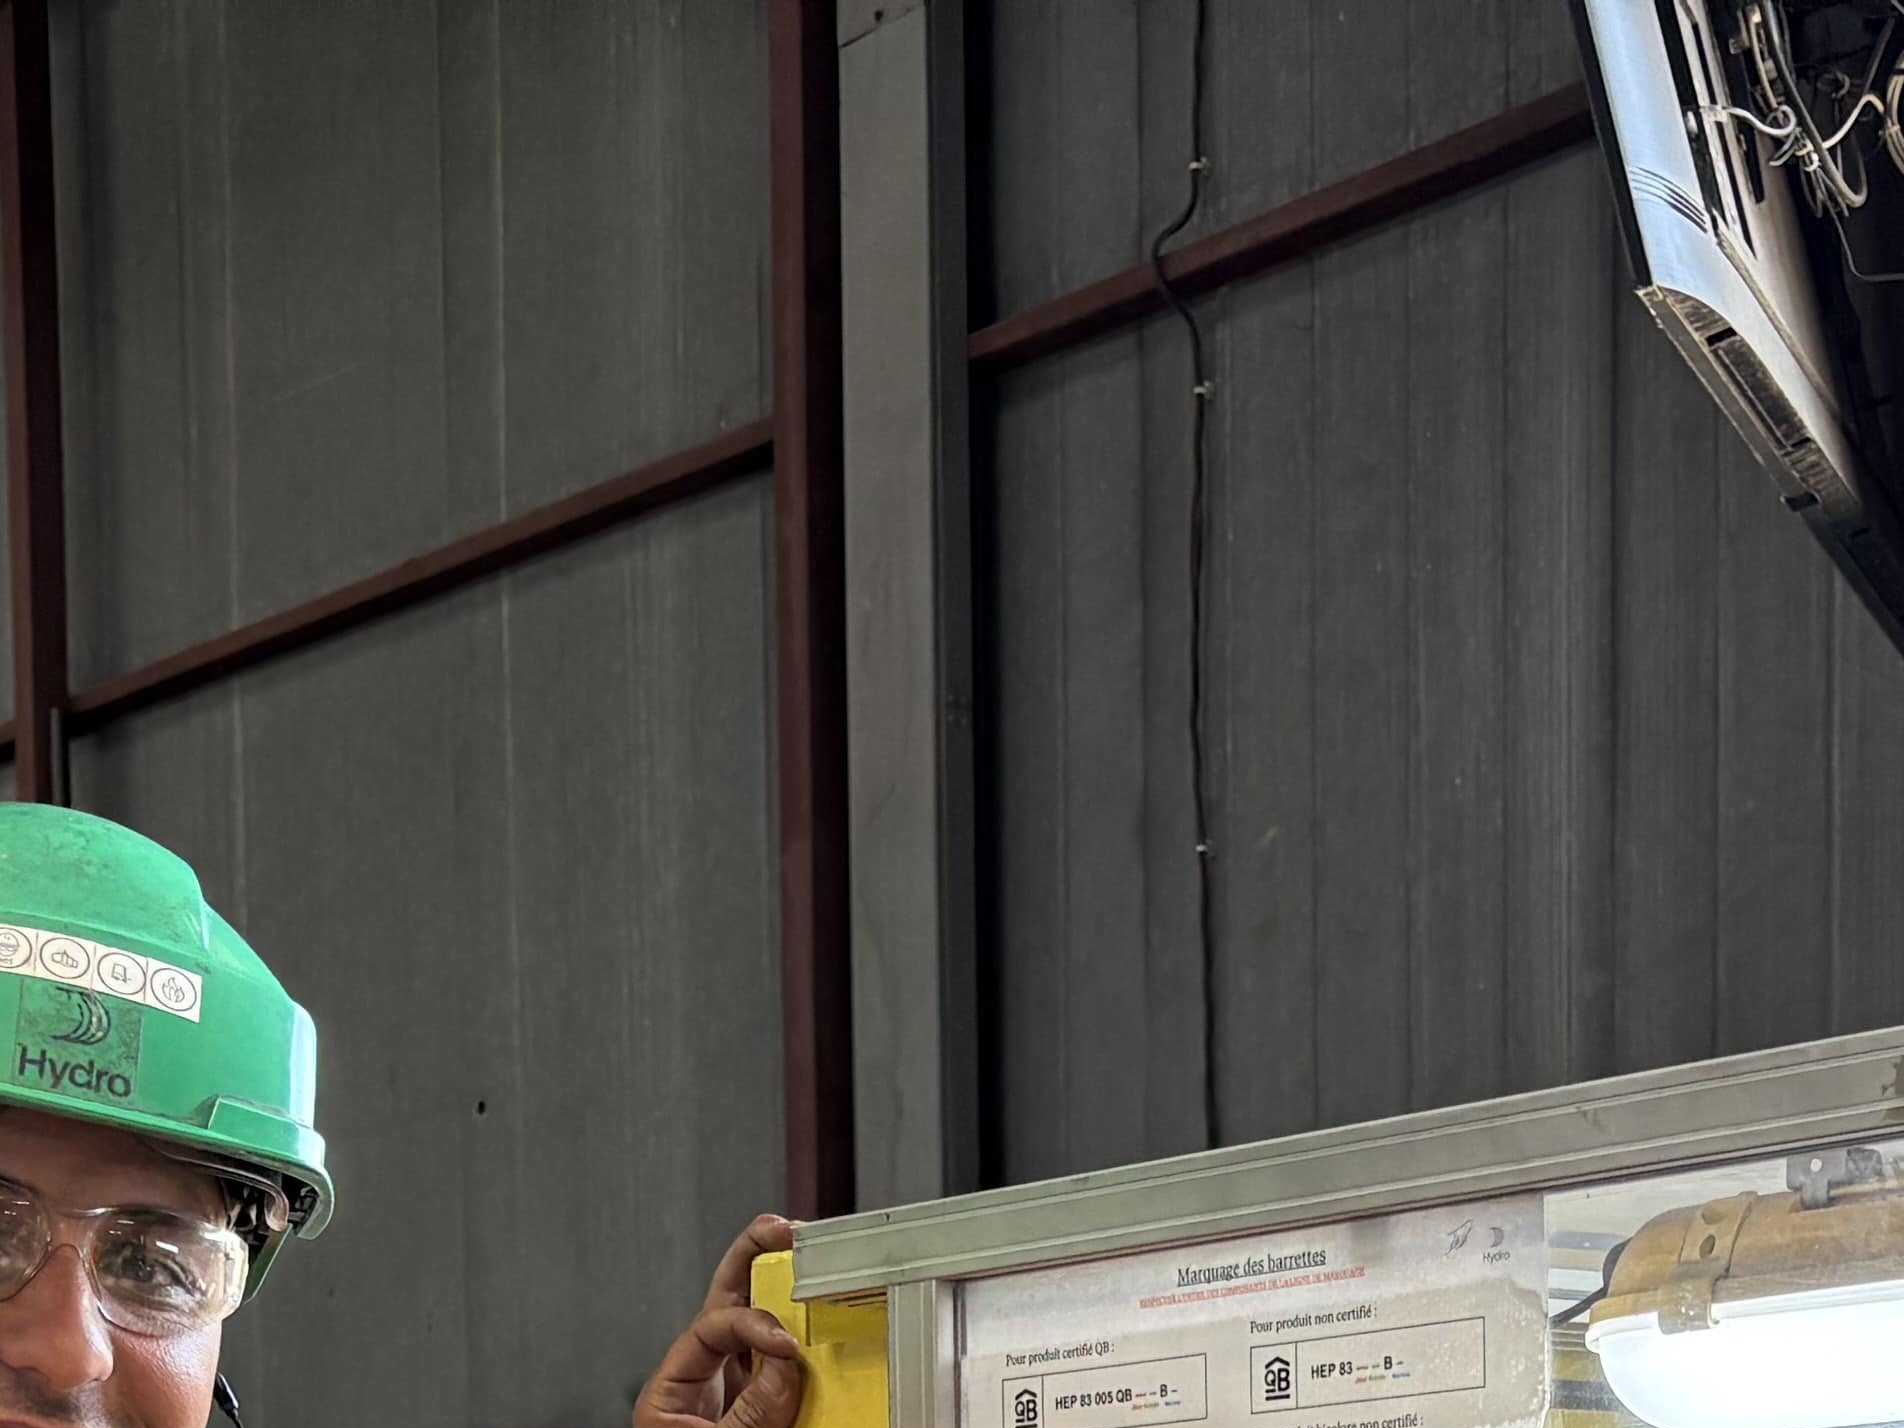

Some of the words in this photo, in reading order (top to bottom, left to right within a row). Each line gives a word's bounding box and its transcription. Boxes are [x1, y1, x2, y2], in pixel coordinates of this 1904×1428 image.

[18, 1045, 132, 1097] Hydro
[1177, 1262, 1240, 1287] Marquage
[1244, 1256, 1265, 1276] des
[1267, 1250, 1327, 1271] barrettes
[1482, 1251, 1511, 1264] Hydro
[1250, 1320, 1272, 1334] Pour
[1276, 1312, 1312, 1333] produit
[1315, 1314, 1334, 1325] non
[1336, 1304, 1371, 1322] certifié
[1006, 1354, 1026, 1367] Pour
[1028, 1348, 1060, 1366] produit
[1062, 1344, 1093, 1359] certifié
[1095, 1341, 1109, 1356] QB
[1311, 1363, 1336, 1380] HEP
[1339, 1361, 1353, 1376] 83
[1384, 1356, 1393, 1369] B
[1055, 1394, 1076, 1410] HEP
[1080, 1393, 1092, 1407] 83
[1095, 1391, 1114, 1406] 005
[1116, 1388, 1132, 1404] QB
[1160, 1384, 1168, 1398] B
